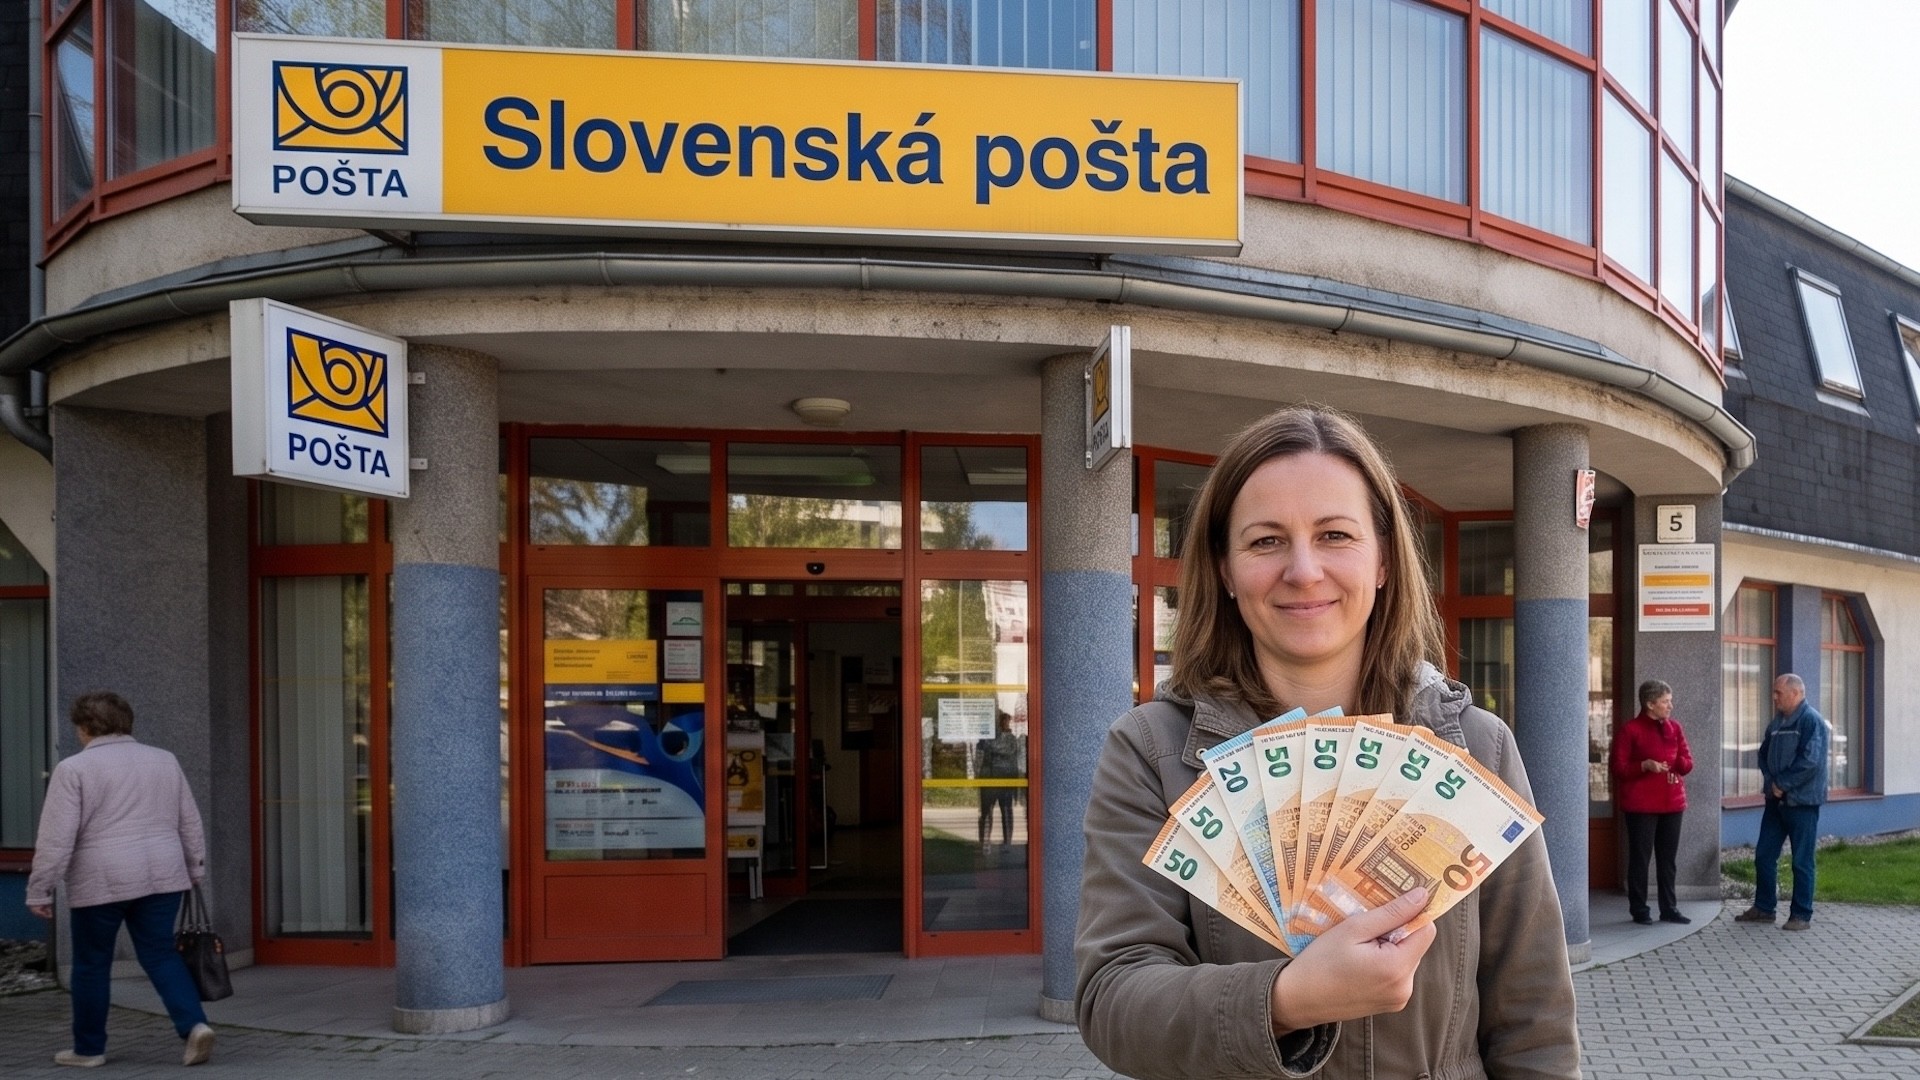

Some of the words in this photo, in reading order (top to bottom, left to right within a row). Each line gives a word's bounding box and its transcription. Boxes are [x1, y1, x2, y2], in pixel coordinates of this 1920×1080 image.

[484, 97, 942, 185] Slovenská
[976, 120, 1209, 204] pošta
[273, 159, 409, 198] POŠTA
[287, 431, 391, 479] POŠTA
[1669, 515, 1683, 532] 5
[1264, 745, 1292, 778] 50
[1312, 738, 1338, 770] 50
[1355, 737, 1384, 770] 50
[1400, 748, 1431, 782] 50
[1218, 761, 1249, 793] 20
[1434, 768, 1467, 800] 50
[1189, 805, 1224, 840] 50
[1163, 848, 1199, 881] 50
[1442, 843, 1494, 892] 50
